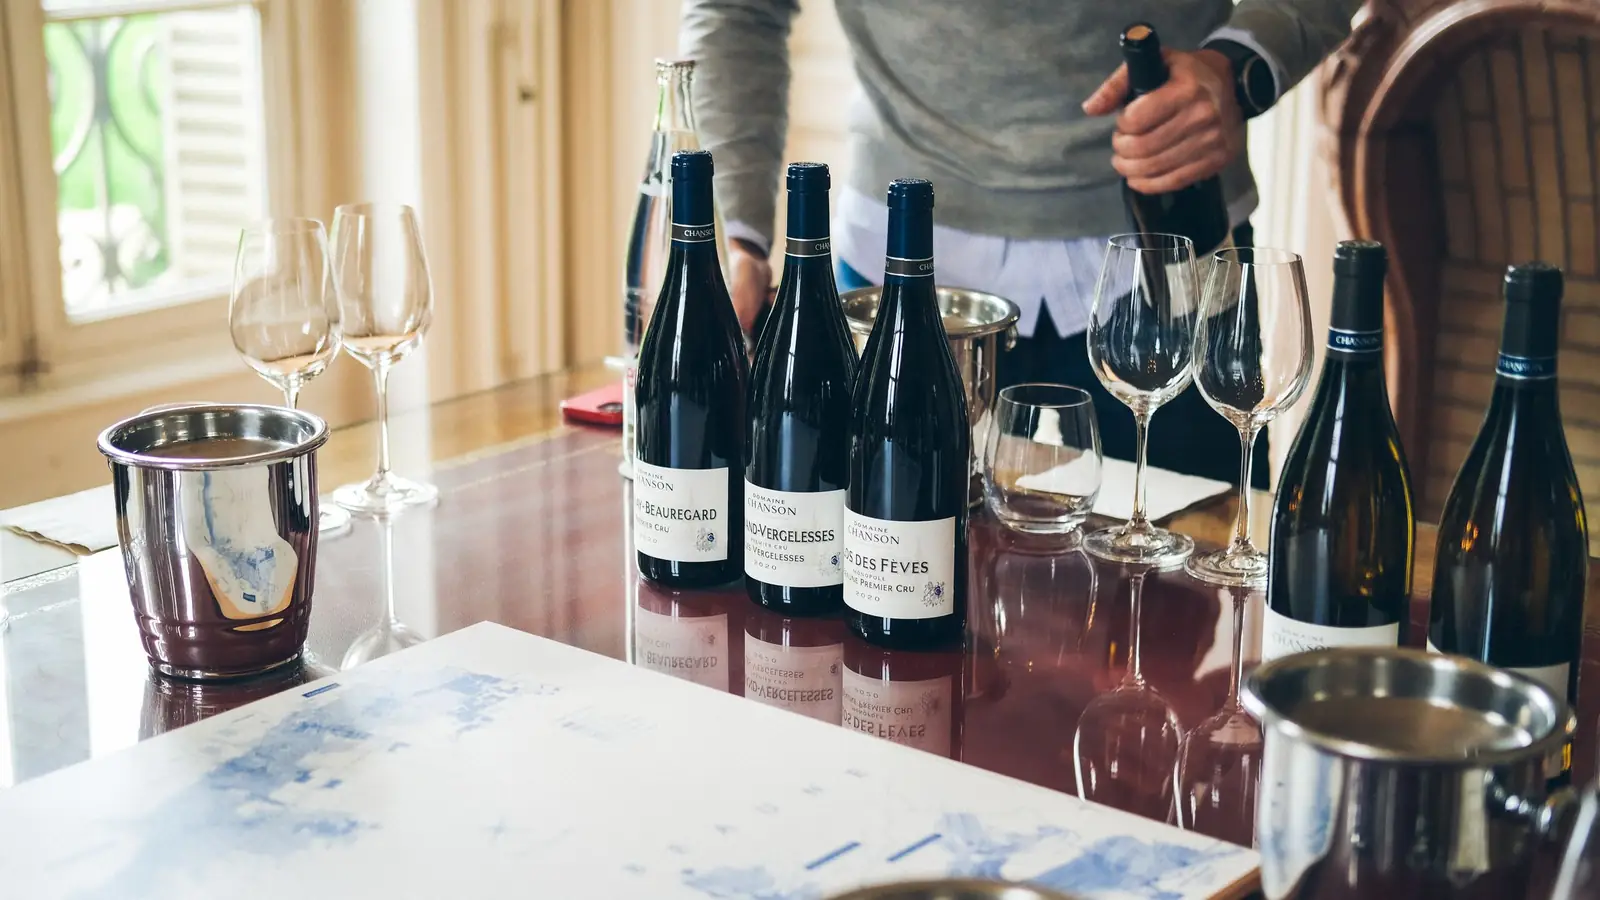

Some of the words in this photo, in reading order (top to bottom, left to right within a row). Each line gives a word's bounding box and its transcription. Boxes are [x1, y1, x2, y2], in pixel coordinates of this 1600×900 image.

[636, 472, 674, 492] HANSON
[747, 497, 797, 516] CHANSON
[753, 493, 785, 505] DOMAINE
[848, 525, 900, 545] CHANSON
[854, 521, 888, 534] DOMAINE
[752, 545, 805, 563] VERGELESSES
[856, 553, 877, 571] DES
[881, 558, 929, 574] FÈVES
[860, 578, 893, 592] PREMIER
[896, 584, 915, 593] CRU
[856, 590, 880, 602] 2020
